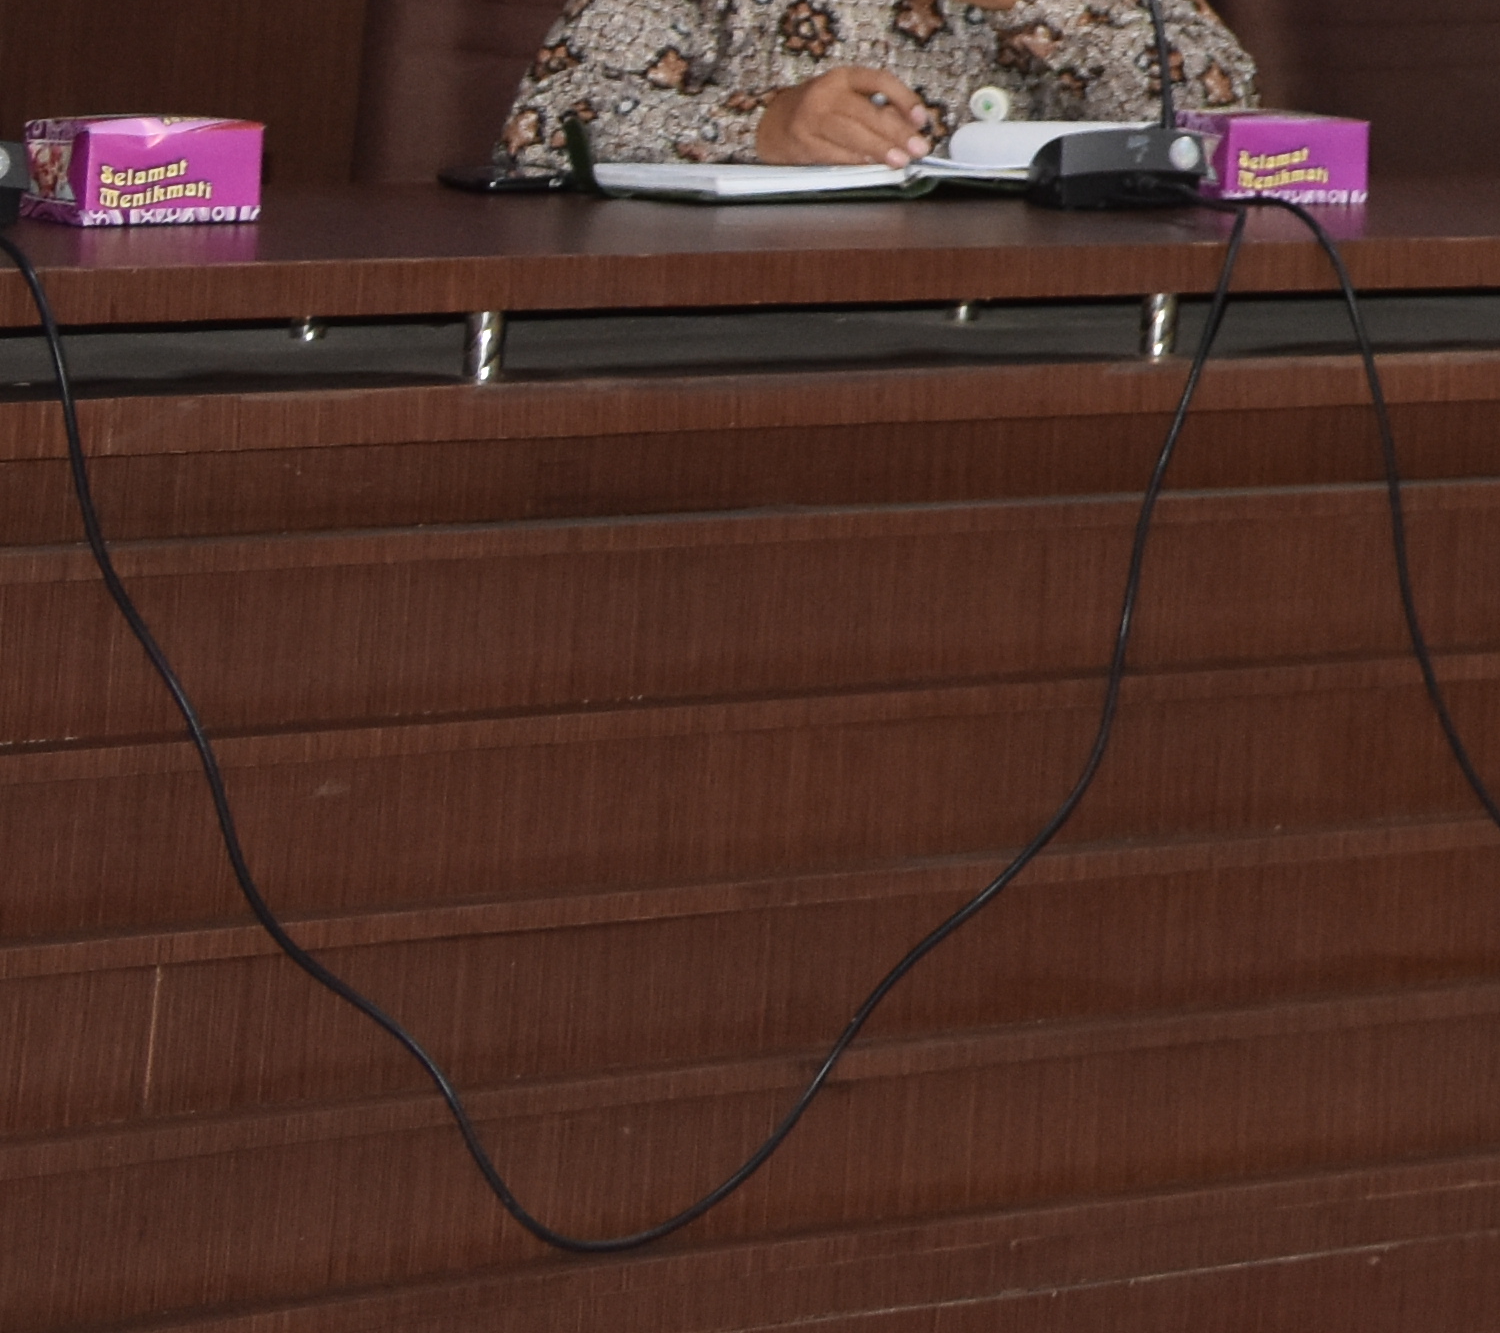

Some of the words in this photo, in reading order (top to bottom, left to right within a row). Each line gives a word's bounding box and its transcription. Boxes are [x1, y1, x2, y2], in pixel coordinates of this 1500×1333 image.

[1238, 146, 1309, 170] Selamat
[100, 159, 189, 187] Selamat
[99, 180, 213, 209] Menikmati
